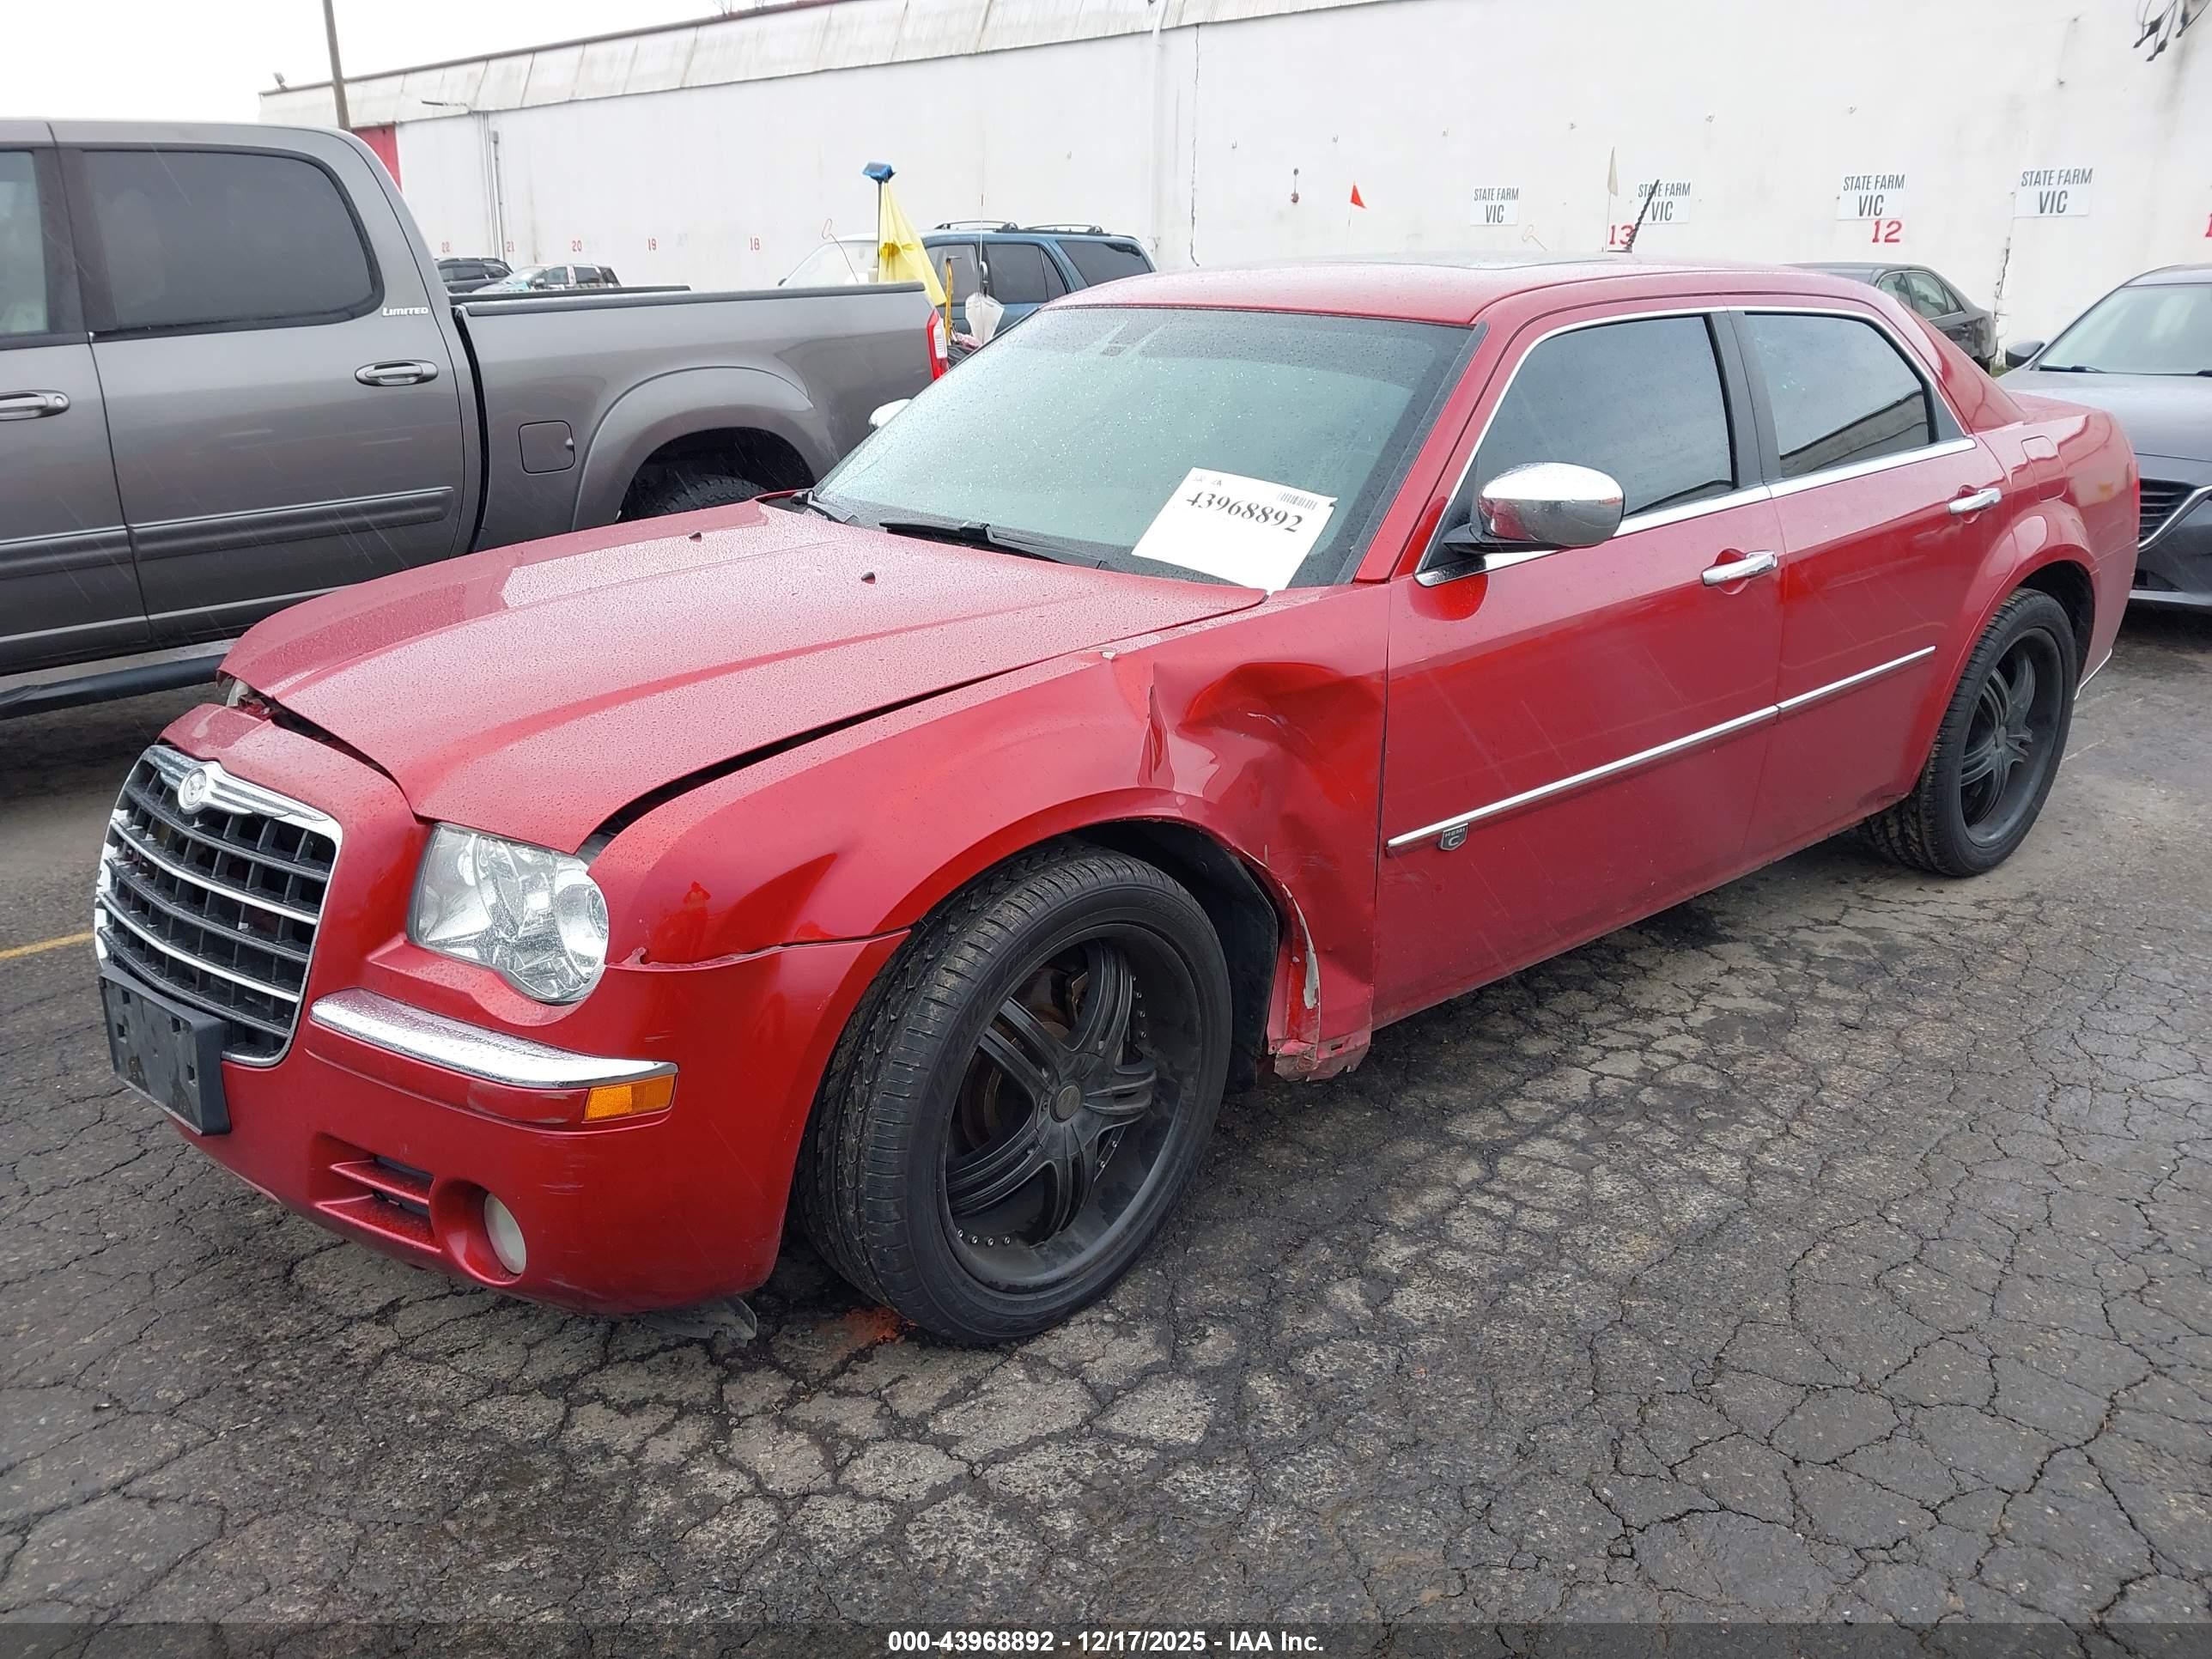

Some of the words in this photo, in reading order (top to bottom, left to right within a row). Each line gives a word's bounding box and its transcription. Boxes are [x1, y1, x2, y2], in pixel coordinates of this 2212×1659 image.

[1843, 175, 1871, 191] STATE
[1874, 174, 1905, 190] FARM
[2021, 169, 2053, 186] STATE
[2057, 168, 2093, 185] FARM
[1474, 188, 1495, 201] STATE
[1497, 187, 1519, 201] FARM
[1665, 182, 1691, 197] FARM
[1651, 201, 1674, 221] VIC
[1858, 194, 1884, 216] VIC
[2039, 191, 2068, 214] VIC
[1486, 204, 1504, 223] VIC
[1608, 225, 1637, 245] 13
[1872, 220, 1903, 243] 12
[506, 241, 515, 252] 21
[571, 240, 582, 252] 20
[647, 239, 657, 251] 19
[750, 237, 760, 251] 18
[1186, 491, 1303, 532] 43968892
